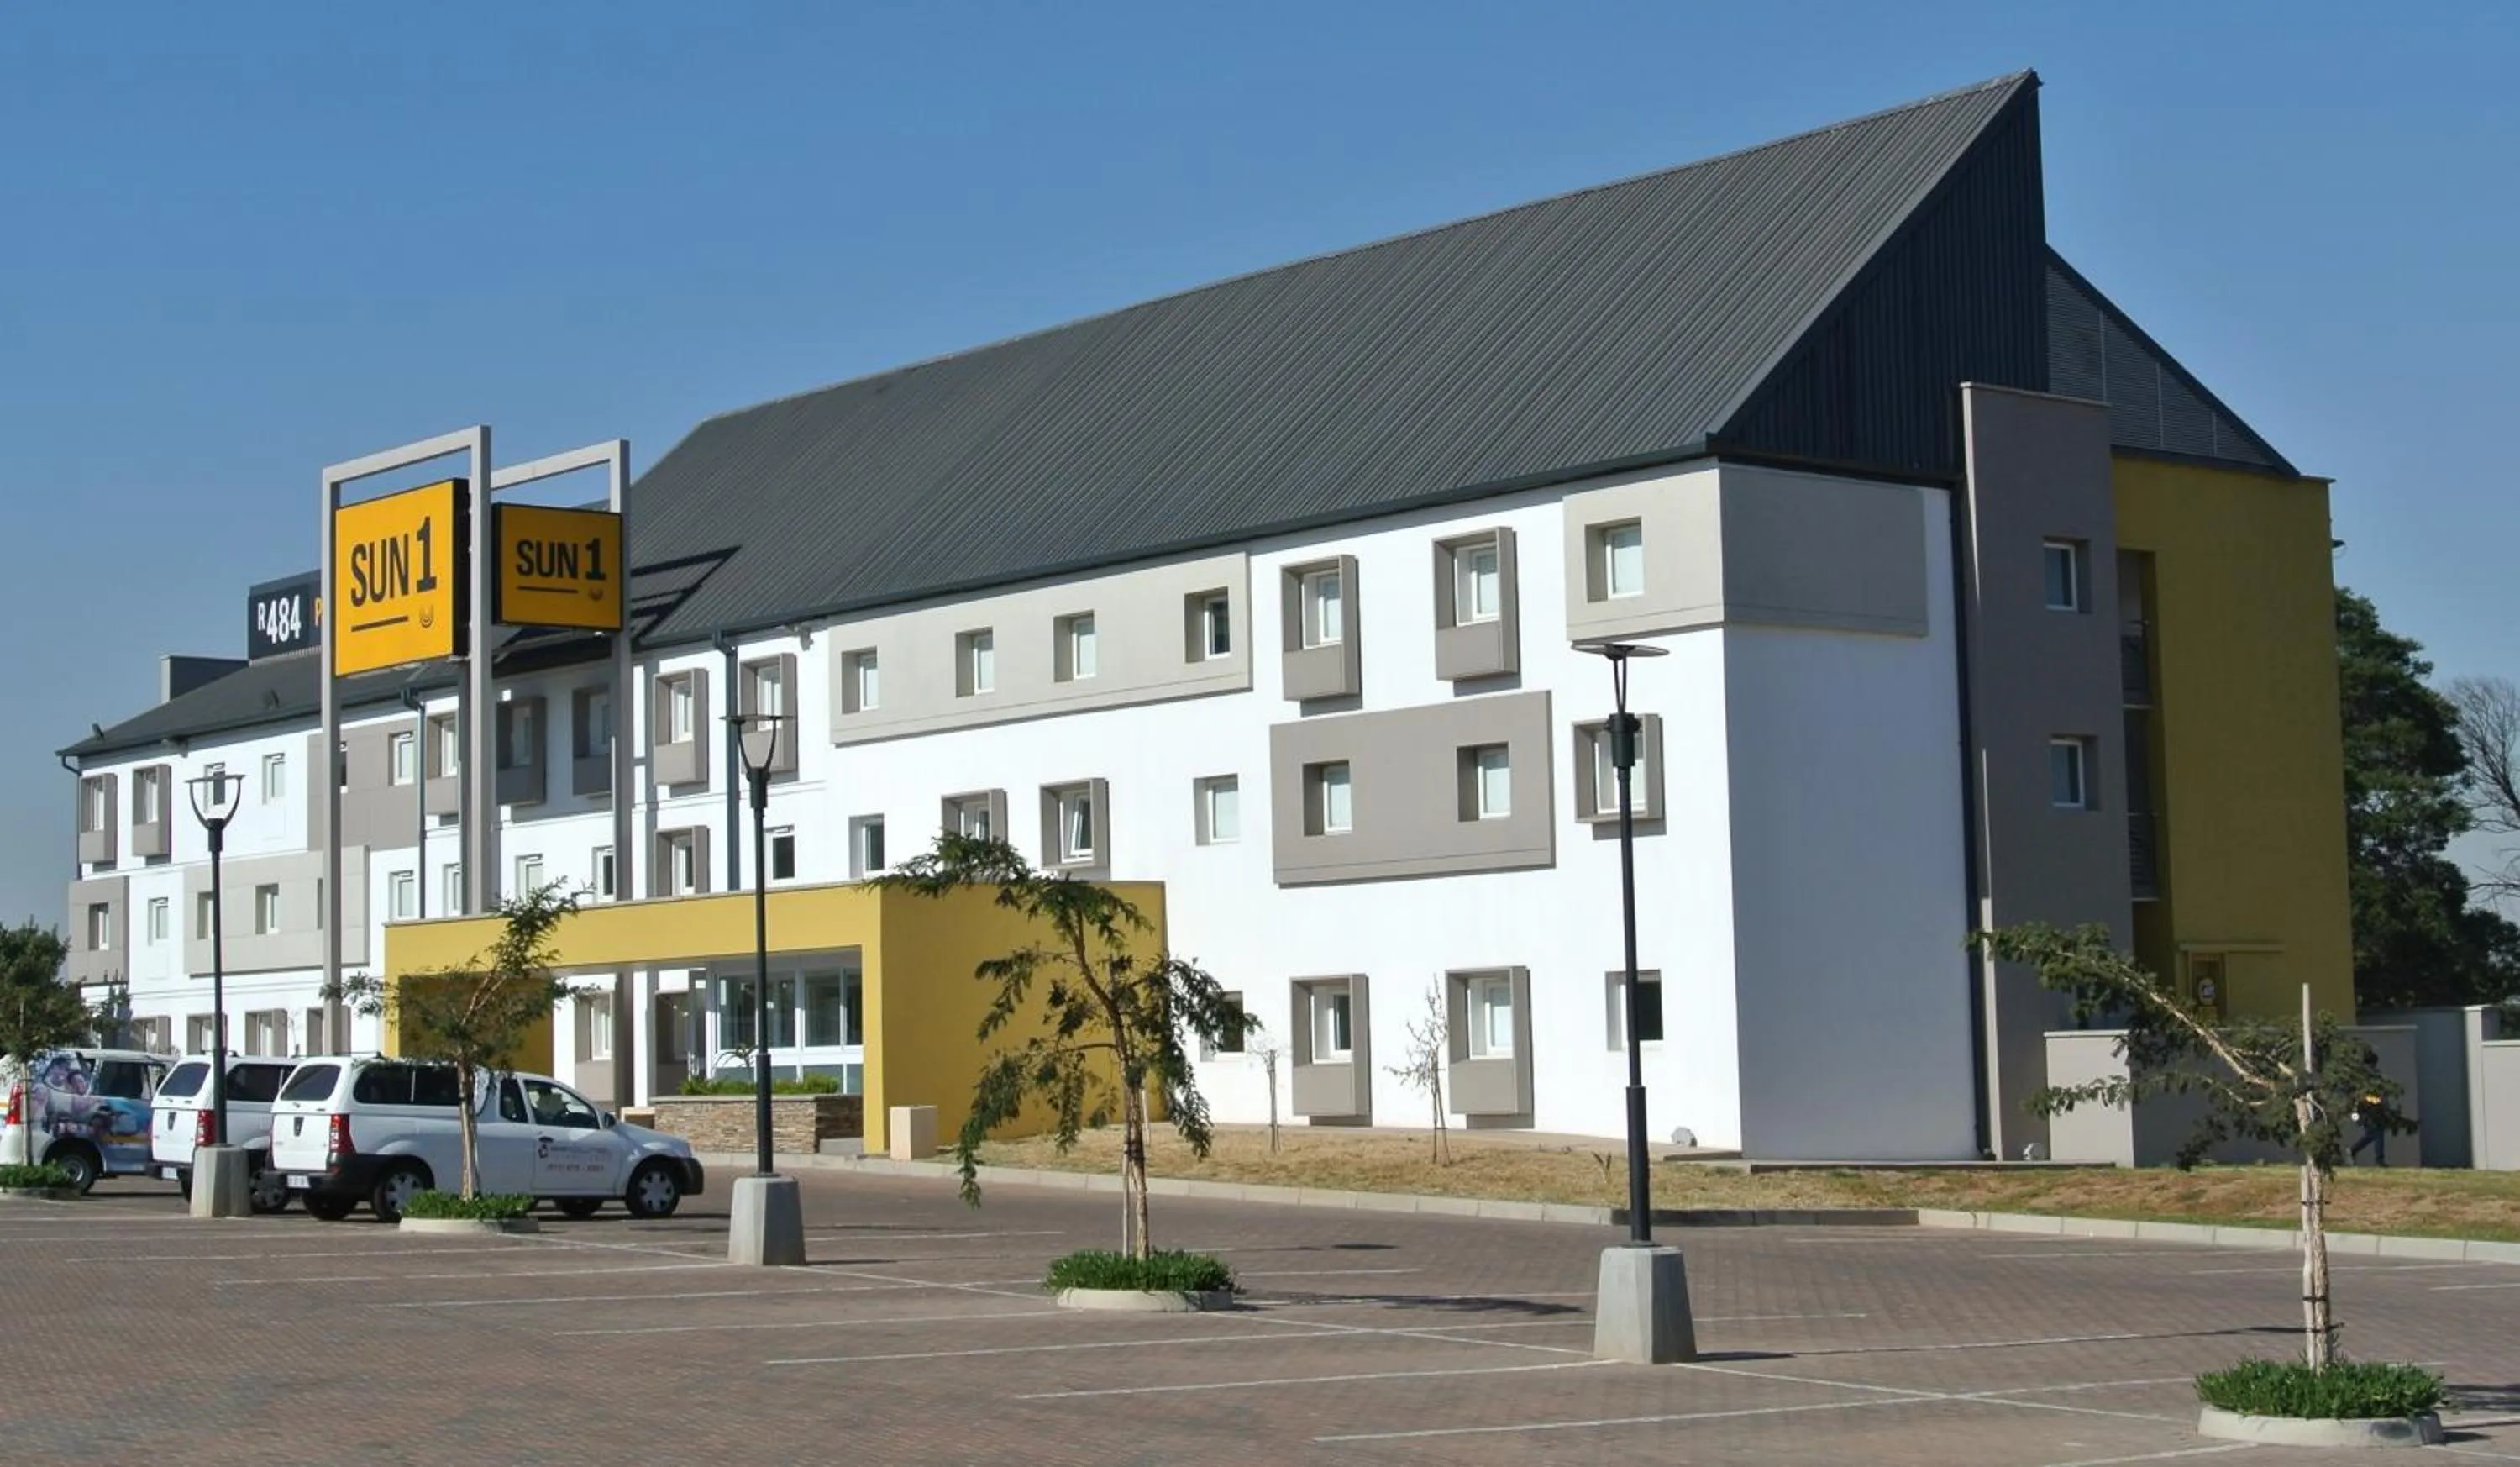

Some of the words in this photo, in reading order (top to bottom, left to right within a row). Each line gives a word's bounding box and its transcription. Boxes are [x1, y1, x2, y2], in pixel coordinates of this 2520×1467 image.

[350, 533, 409, 607] SUN
[416, 516, 437, 593] 1
[517, 539, 579, 579] SUN
[585, 537, 607, 581] 1
[257, 594, 302, 644] R484
